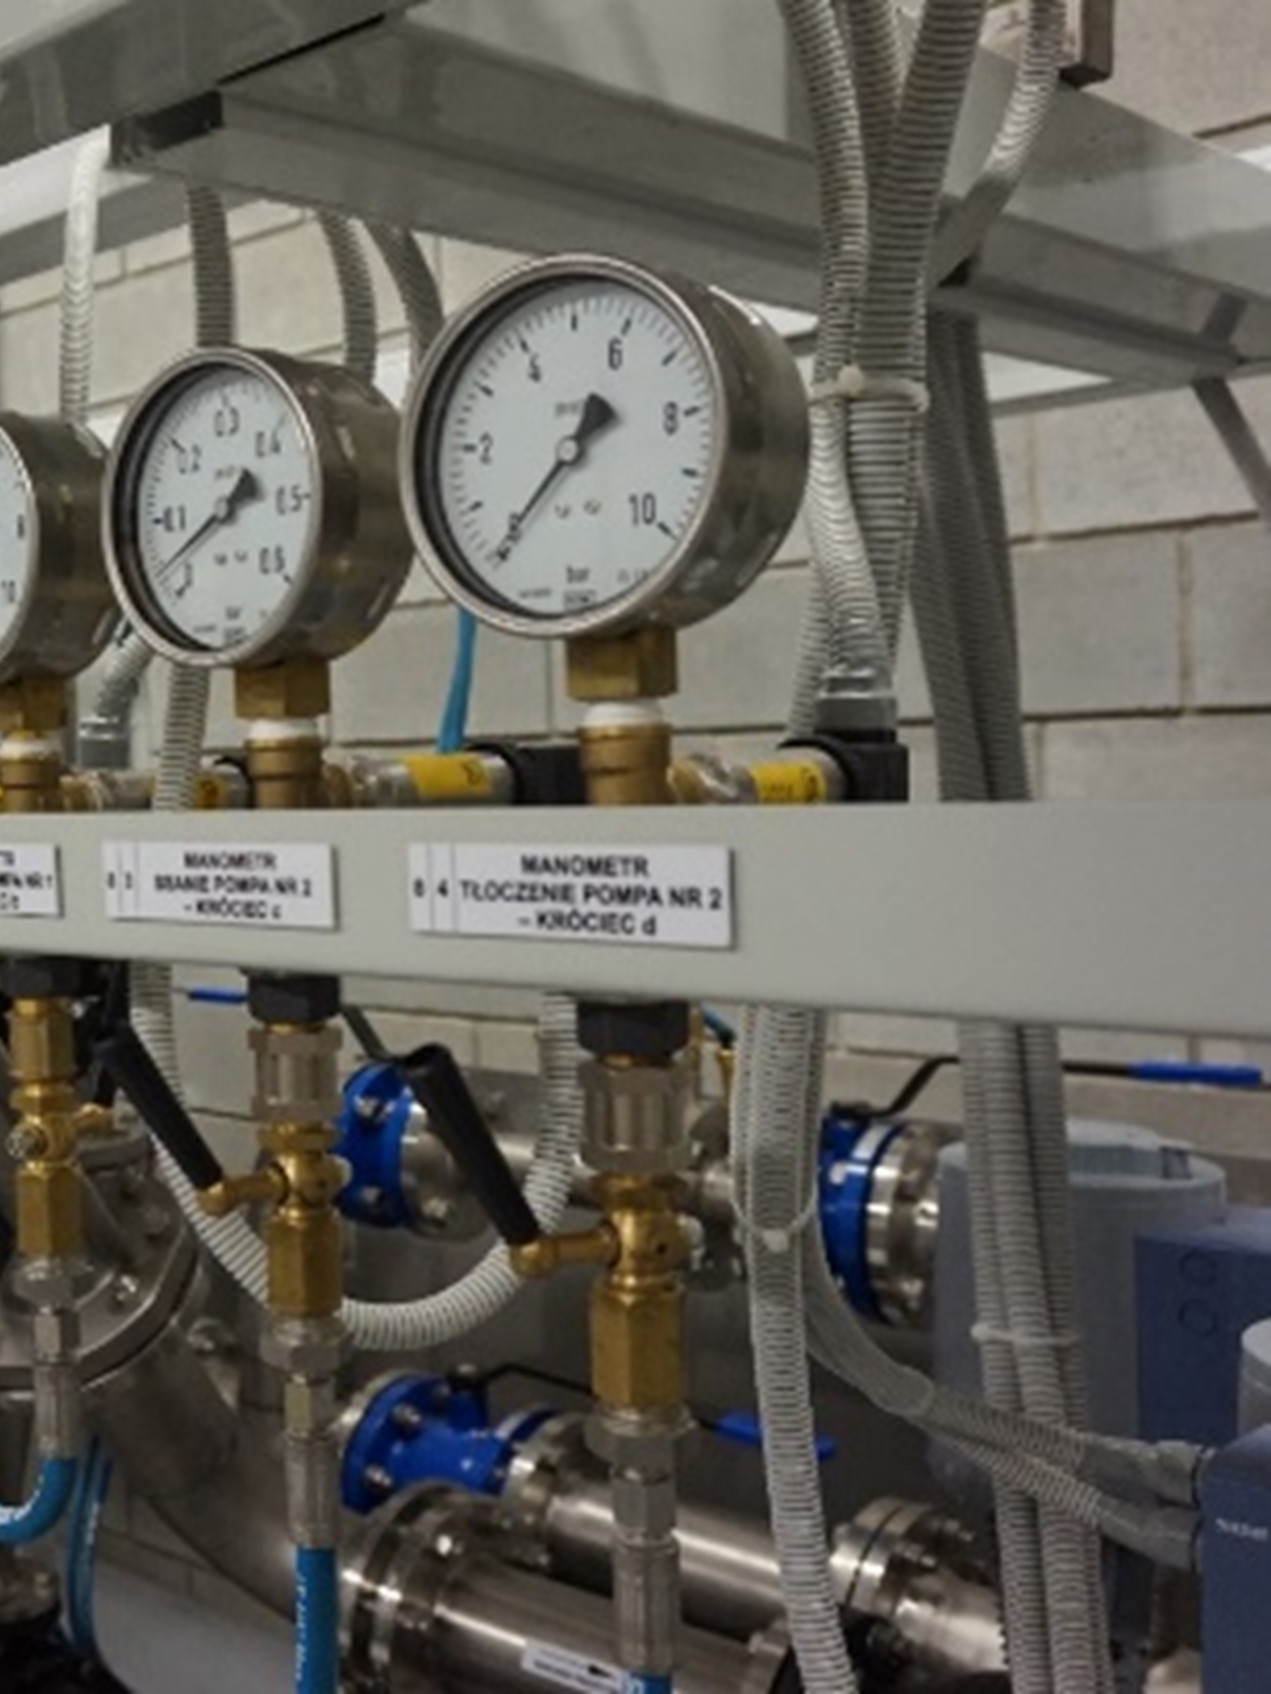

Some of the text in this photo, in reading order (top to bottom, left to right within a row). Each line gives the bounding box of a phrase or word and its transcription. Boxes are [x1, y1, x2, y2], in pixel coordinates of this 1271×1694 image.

[607, 338, 623, 371] 6
[663, 402, 678, 435] 8
[479, 432, 493, 464] 2
[628, 492, 657, 527] 10
[520, 855, 649, 877] MANOMETR
[214, 875, 269, 894] POMPA
[436, 877, 448, 898] 4
[459, 879, 723, 910] TŁOCZENIE POMPA NR 2
[536, 908, 636, 936] KRÓCIEC
[641, 915, 657, 936] d
